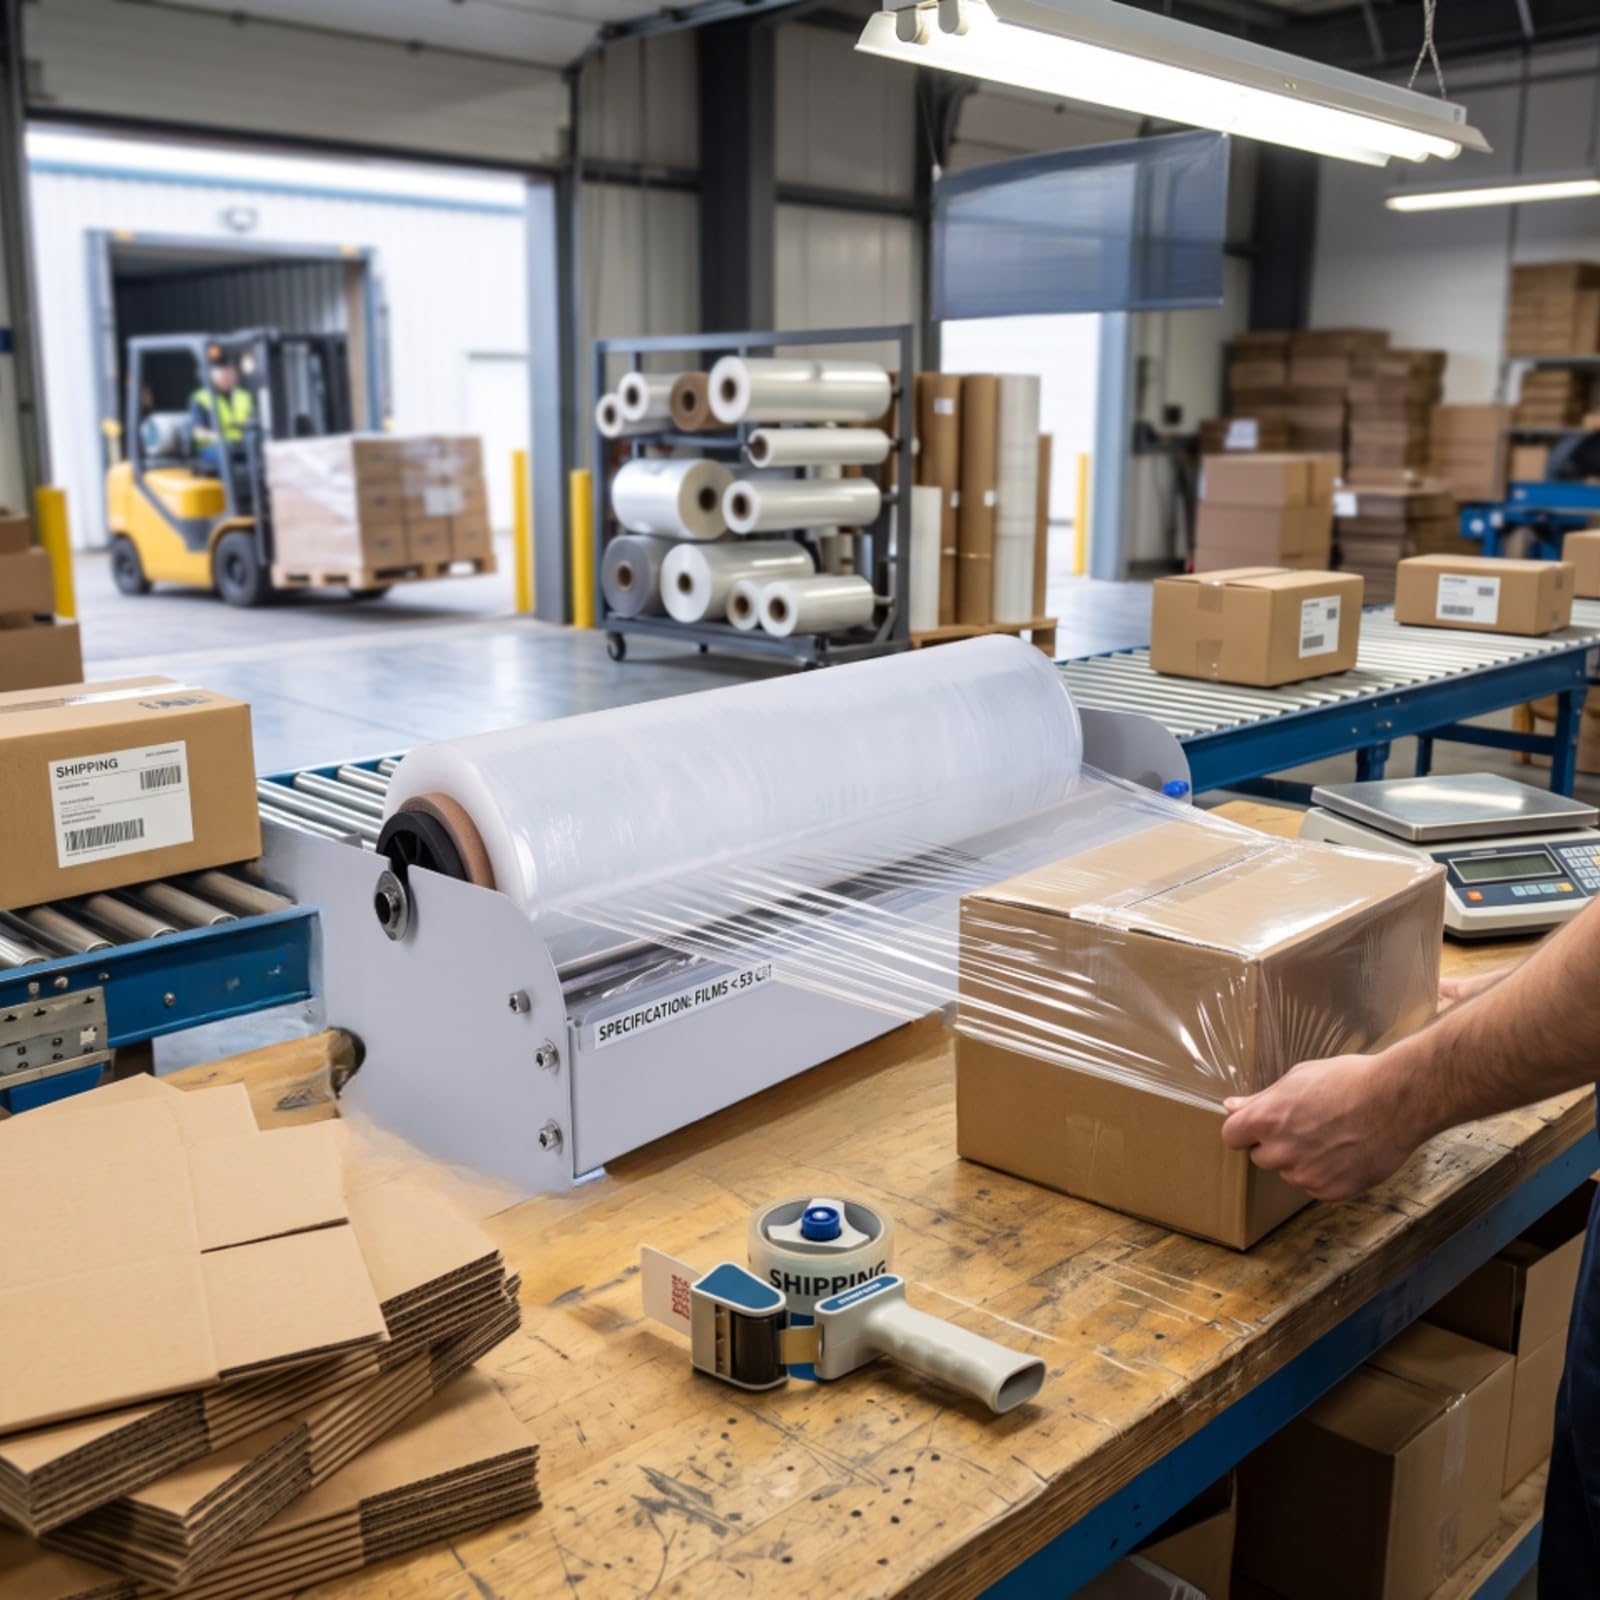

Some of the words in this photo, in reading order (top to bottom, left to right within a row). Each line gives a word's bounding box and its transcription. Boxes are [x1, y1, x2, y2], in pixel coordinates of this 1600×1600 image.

[56, 757, 119, 778] SHIPPING
[599, 994, 692, 1041] SPECIFICATION:
[694, 979, 728, 1005] FILMS
[740, 970, 753, 989] 53
